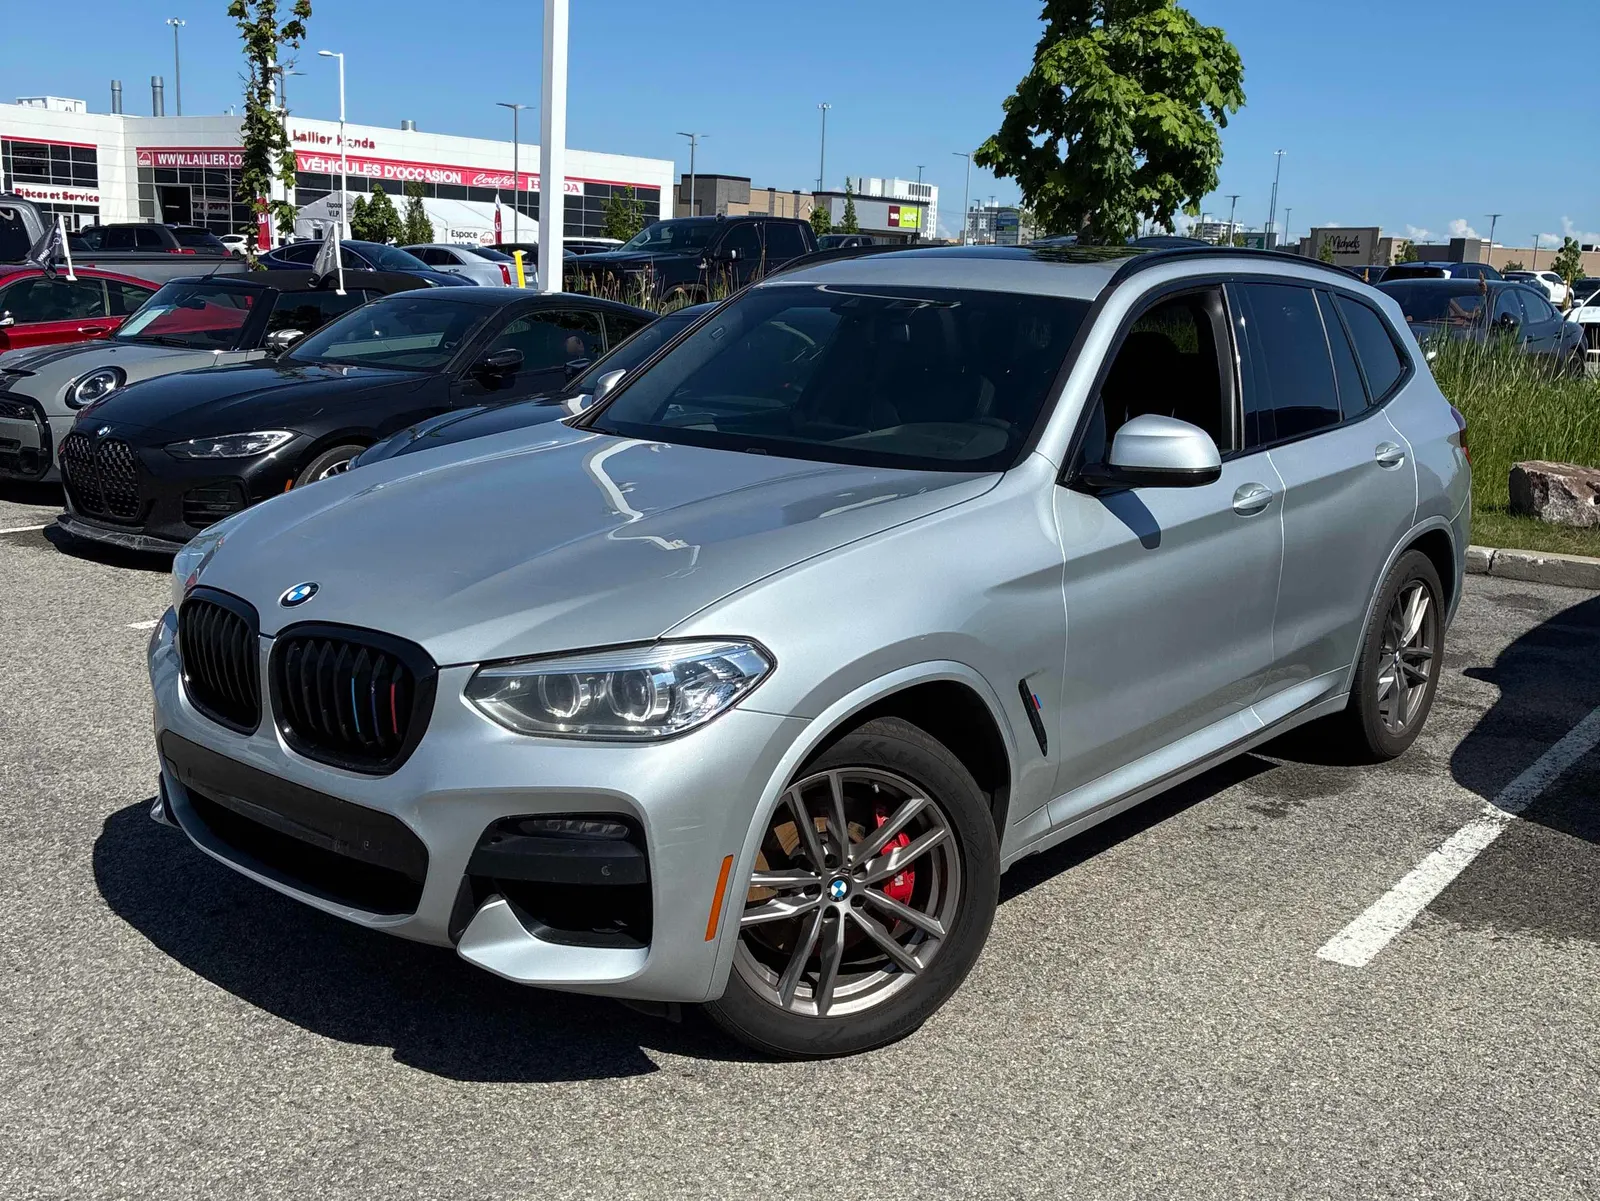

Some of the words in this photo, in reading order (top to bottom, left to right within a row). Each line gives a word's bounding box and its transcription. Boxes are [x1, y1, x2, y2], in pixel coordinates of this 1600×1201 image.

[293, 130, 332, 144] Lallier
[337, 135, 375, 149] Honda
[158, 153, 244, 165] WWW.LALLIER.CO
[301, 157, 381, 176] VÉHICULES
[384, 165, 461, 183] D'OCCASION
[531, 180, 580, 193] HDA
[15, 187, 48, 199] Pièces
[49, 191, 60, 200] et
[62, 191, 99, 202] Service
[451, 229, 477, 239] Espace
[1330, 234, 1360, 250] Michaels
